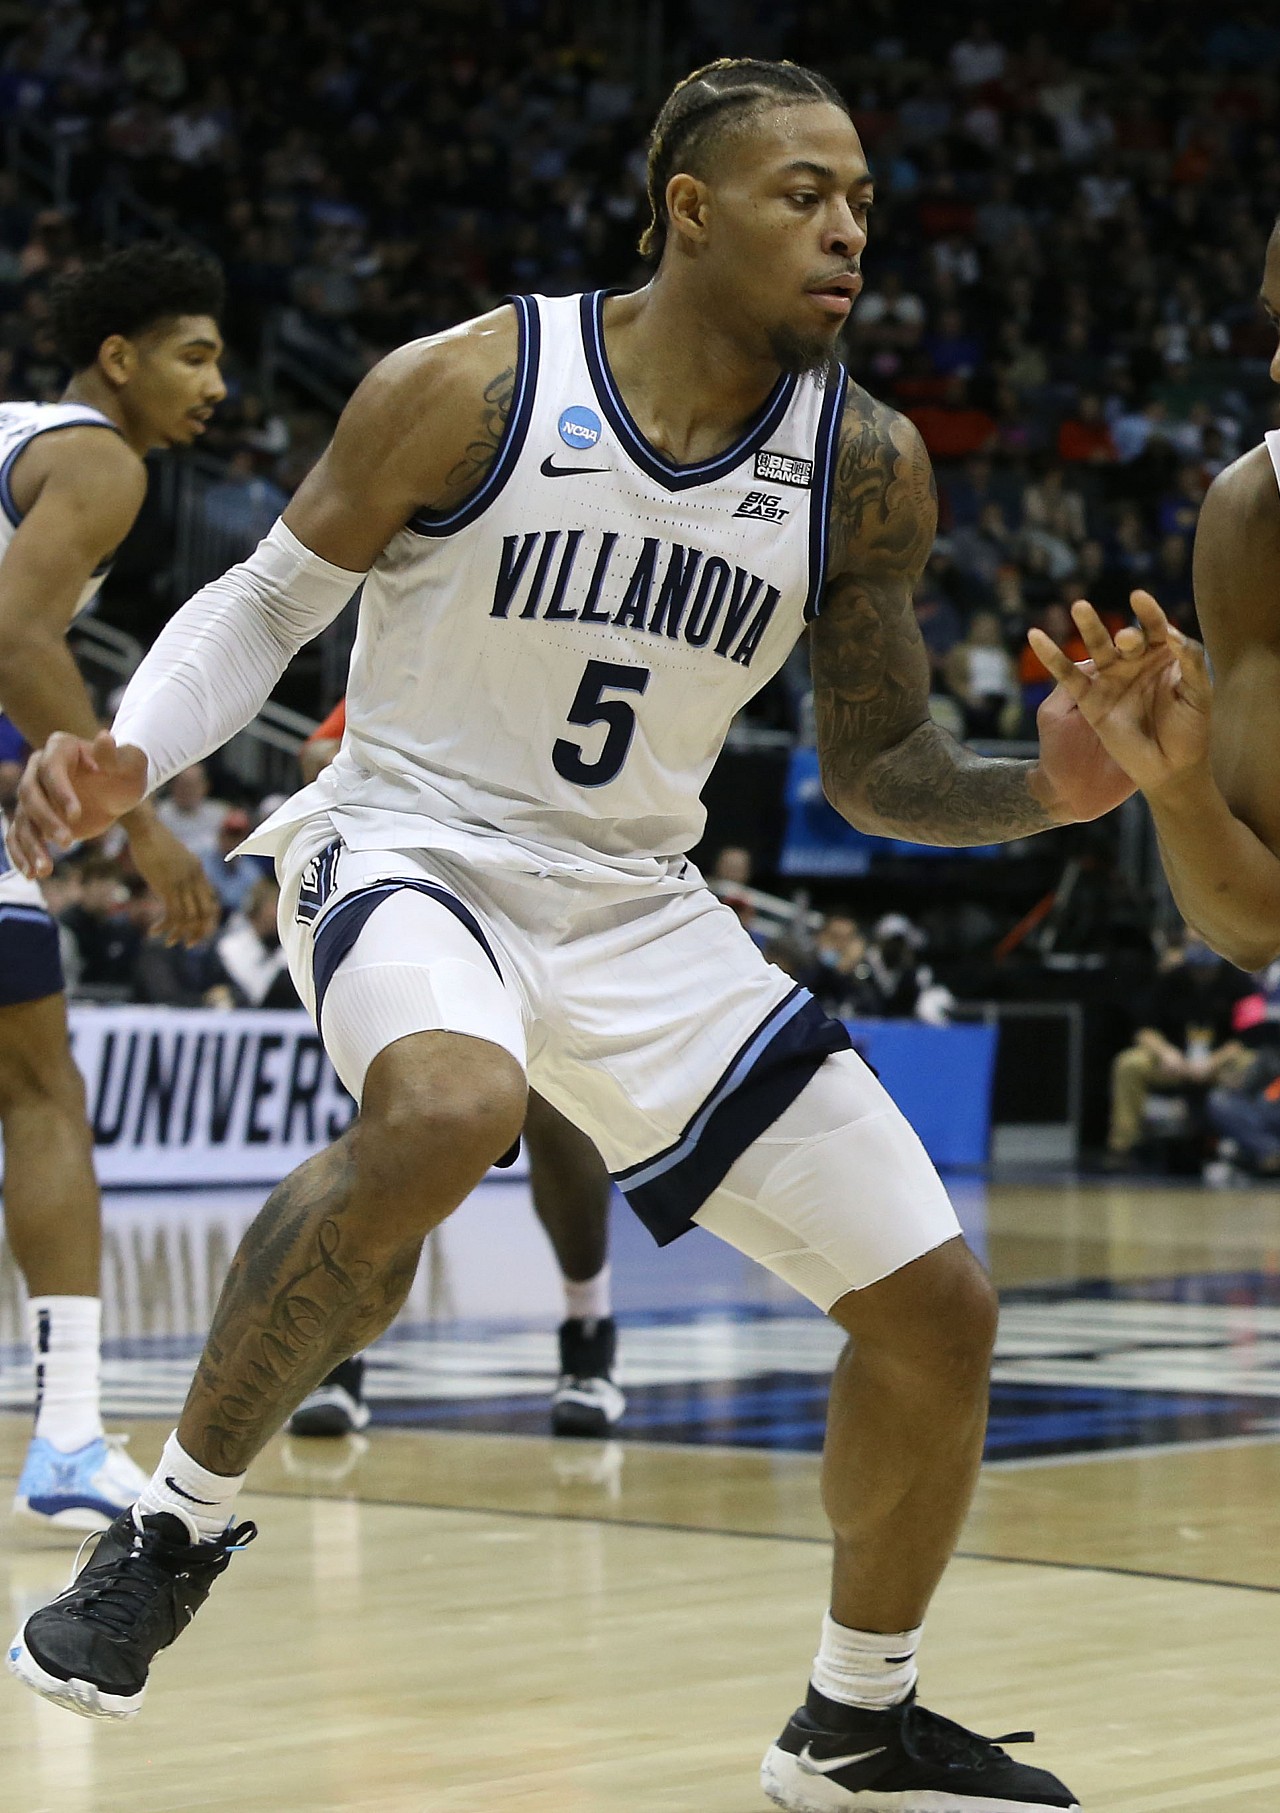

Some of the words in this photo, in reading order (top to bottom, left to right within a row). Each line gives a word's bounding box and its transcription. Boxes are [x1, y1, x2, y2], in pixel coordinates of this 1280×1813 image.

[562, 421, 598, 443] NCAA
[757, 467, 810, 485] CHANGE
[744, 491, 782, 507] BIG
[736, 502, 790, 520] EAST
[489, 529, 782, 667] VILLANOVA
[552, 659, 650, 789] 5
